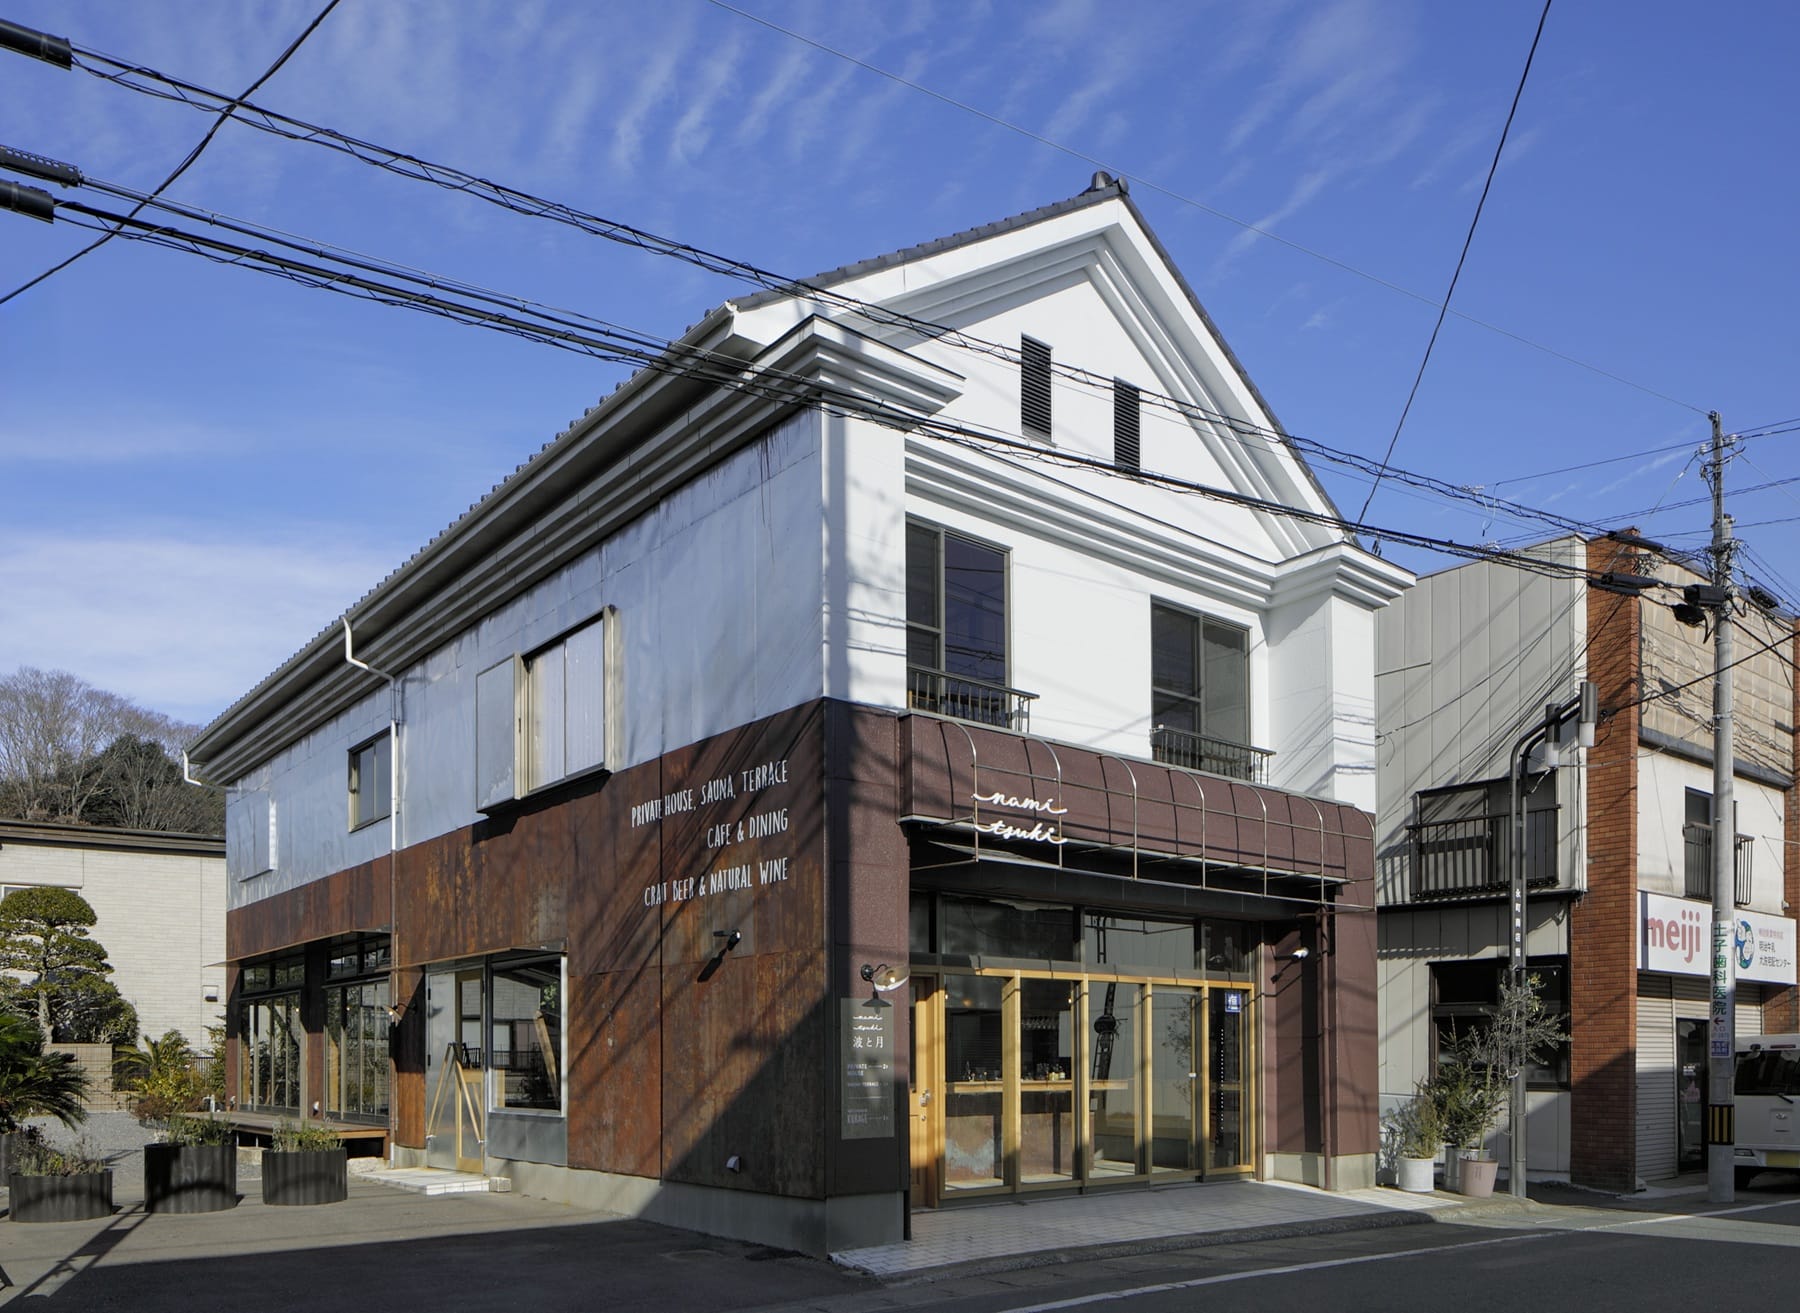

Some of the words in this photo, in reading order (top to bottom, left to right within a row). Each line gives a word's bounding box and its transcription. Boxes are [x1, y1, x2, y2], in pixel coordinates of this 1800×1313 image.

[631, 799, 663, 828] PRIVATE
[664, 789, 697, 816] HOUSE,
[701, 774, 736, 805] SAUNA,
[742, 760, 788, 792] TERRACE
[971, 792, 1068, 814] nami
[707, 823, 731, 848] CAFE
[736, 820, 745, 843] &
[749, 808, 788, 838] DINING
[974, 820, 1068, 844] tsuki
[672, 877, 695, 901] BEER
[698, 878, 706, 897] &
[710, 864, 752, 895] NATURAL
[759, 857, 788, 885] WINE
[1647, 909, 1701, 964] meiji
[853, 1035, 883, 1049] 波と月
